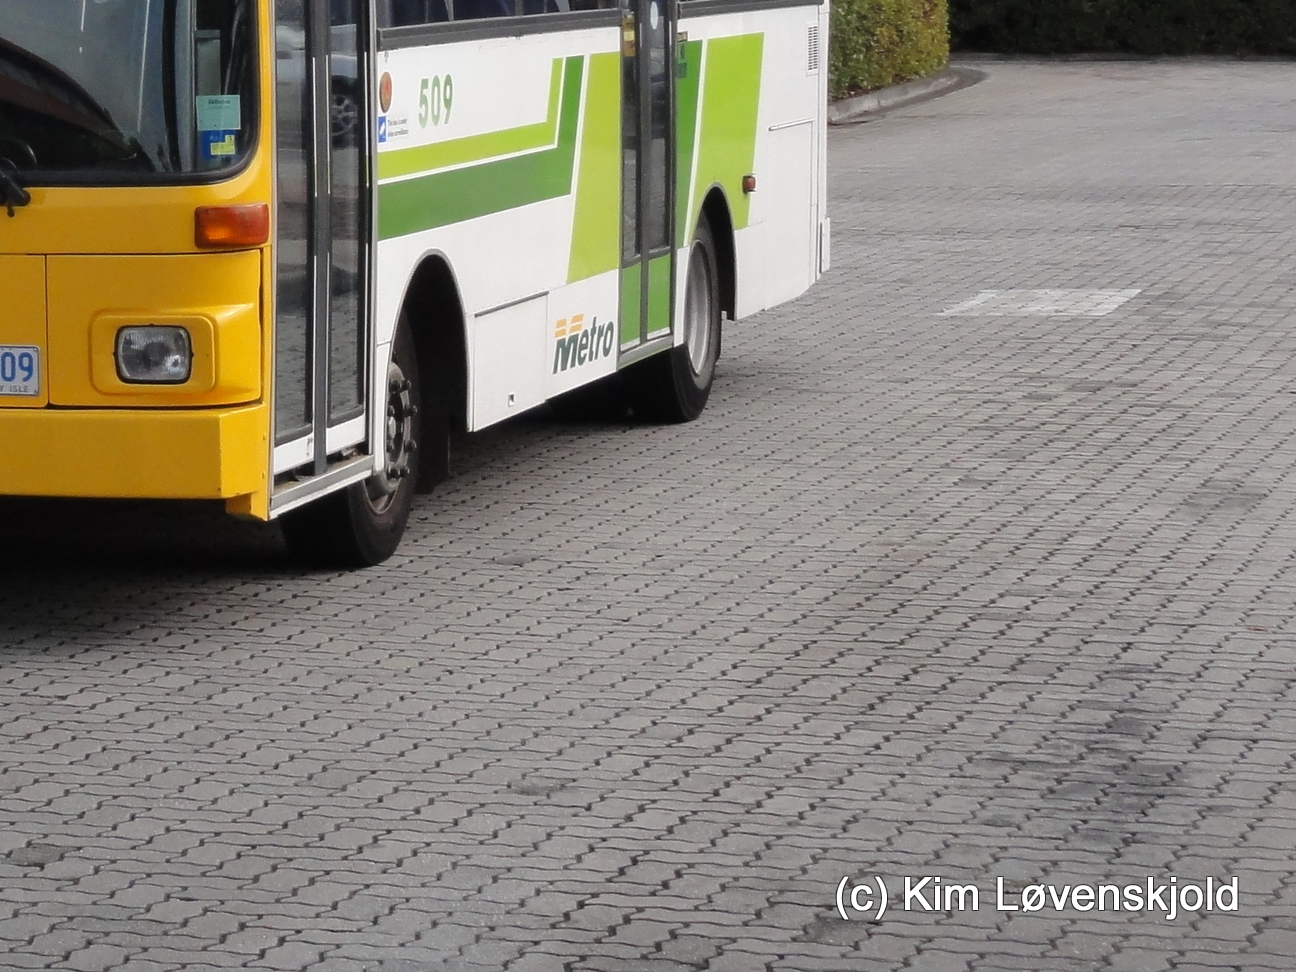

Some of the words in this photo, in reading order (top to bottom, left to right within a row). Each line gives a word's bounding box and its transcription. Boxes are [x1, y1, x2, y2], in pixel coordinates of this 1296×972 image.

[418, 73, 453, 129] 509
[552, 313, 615, 375] Metro
[9, 385, 30, 394] ISLE
